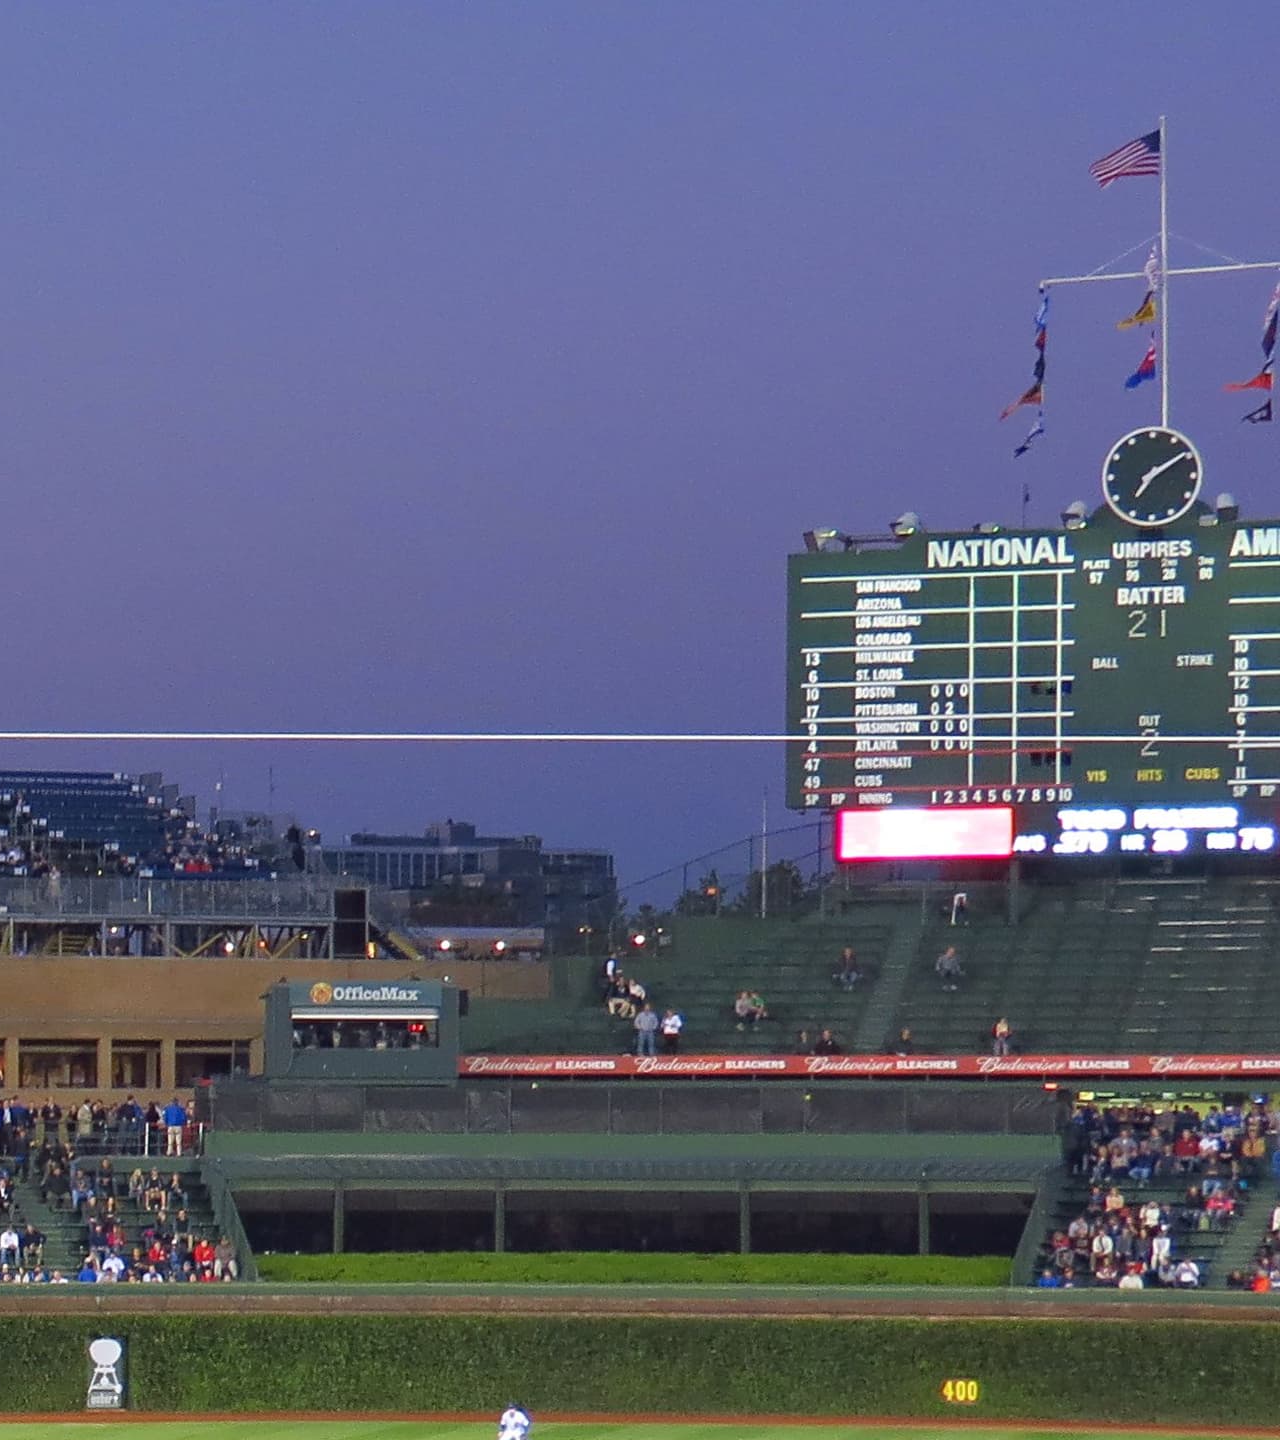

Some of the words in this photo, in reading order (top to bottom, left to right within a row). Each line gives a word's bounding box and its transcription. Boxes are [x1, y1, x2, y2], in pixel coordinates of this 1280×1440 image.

[927, 536, 1074, 568] NATIONAL
[1112, 540, 1192, 559] UMPIRES
[856, 580, 873, 593] SAN
[875, 579, 921, 592] FRANCISCO
[1117, 586, 1185, 605] BATTER
[856, 598, 902, 610] ARIZONA
[856, 616, 871, 628] LOS
[1128, 609, 1167, 638] 21
[856, 632, 912, 645] COLORADO
[1234, 640, 1249, 653] 10
[805, 653, 820, 666] 13
[855, 650, 914, 664] MILWAUKEE
[1092, 657, 1119, 669] BALL
[1176, 654, 1214, 666] STRIKE
[1234, 658, 1249, 671] 10
[809, 670, 818, 683] 6
[856, 669, 869, 681] ST.
[873, 668, 903, 680] LOUIS
[1234, 677, 1249, 689] 12
[806, 688, 819, 701] 10
[855, 687, 896, 699] BOSTON
[931, 685, 940, 698] 0
[945, 685, 954, 697] 0
[959, 684, 968, 697] 0
[1234, 694, 1248, 706] 10
[806, 705, 819, 718] 17
[855, 703, 918, 716] PITTSBURGH
[931, 703, 940, 715] 0
[945, 702, 954, 715] 2
[1139, 714, 1160, 726] OUT
[1236, 713, 1246, 725] 6
[808, 723, 817, 735] 9
[855, 722, 920, 734] WASHINGTON
[930, 721, 939, 733] 0
[945, 721, 954, 733] 0
[959, 720, 968, 733] 0
[808, 741, 817, 753] 4
[855, 739, 898, 752] ATLANTA
[1141, 728, 1159, 756] 2
[804, 759, 820, 771] 47
[855, 757, 912, 770] CINCINNATI
[1087, 770, 1107, 782] VIS
[1137, 769, 1162, 781] HITS
[1185, 768, 1219, 780] CUBS
[1235, 767, 1246, 779] 11
[804, 776, 820, 789] 49
[855, 775, 883, 787] CUBS
[858, 793, 893, 805] INNING
[931, 791, 937, 804] 1
[944, 790, 953, 804] 2
[959, 790, 968, 803] 3
[972, 790, 982, 803] 4
[988, 789, 997, 802] 5
[1002, 789, 1012, 802] 6
[1017, 789, 1025, 801] 7
[1031, 789, 1041, 801] 8
[1046, 788, 1056, 801] 9
[1058, 788, 1072, 801] 10
[1233, 786, 1247, 797] SP
[334, 987, 418, 1001] OfficeMax
[465, 1056, 551, 1072] Budweiser
[555, 1060, 615, 1070] BLEACHERS
[634, 1056, 723, 1072] Budweiser
[725, 1060, 786, 1070] BLEACHERS
[805, 1056, 894, 1072] Budweiser
[896, 1060, 957, 1070] BLEACHERS
[976, 1056, 1066, 1072] Budweiser
[1068, 1060, 1129, 1070] BLEACHERS
[1149, 1056, 1239, 1072] Budweiser
[943, 1380, 978, 1401] 400
